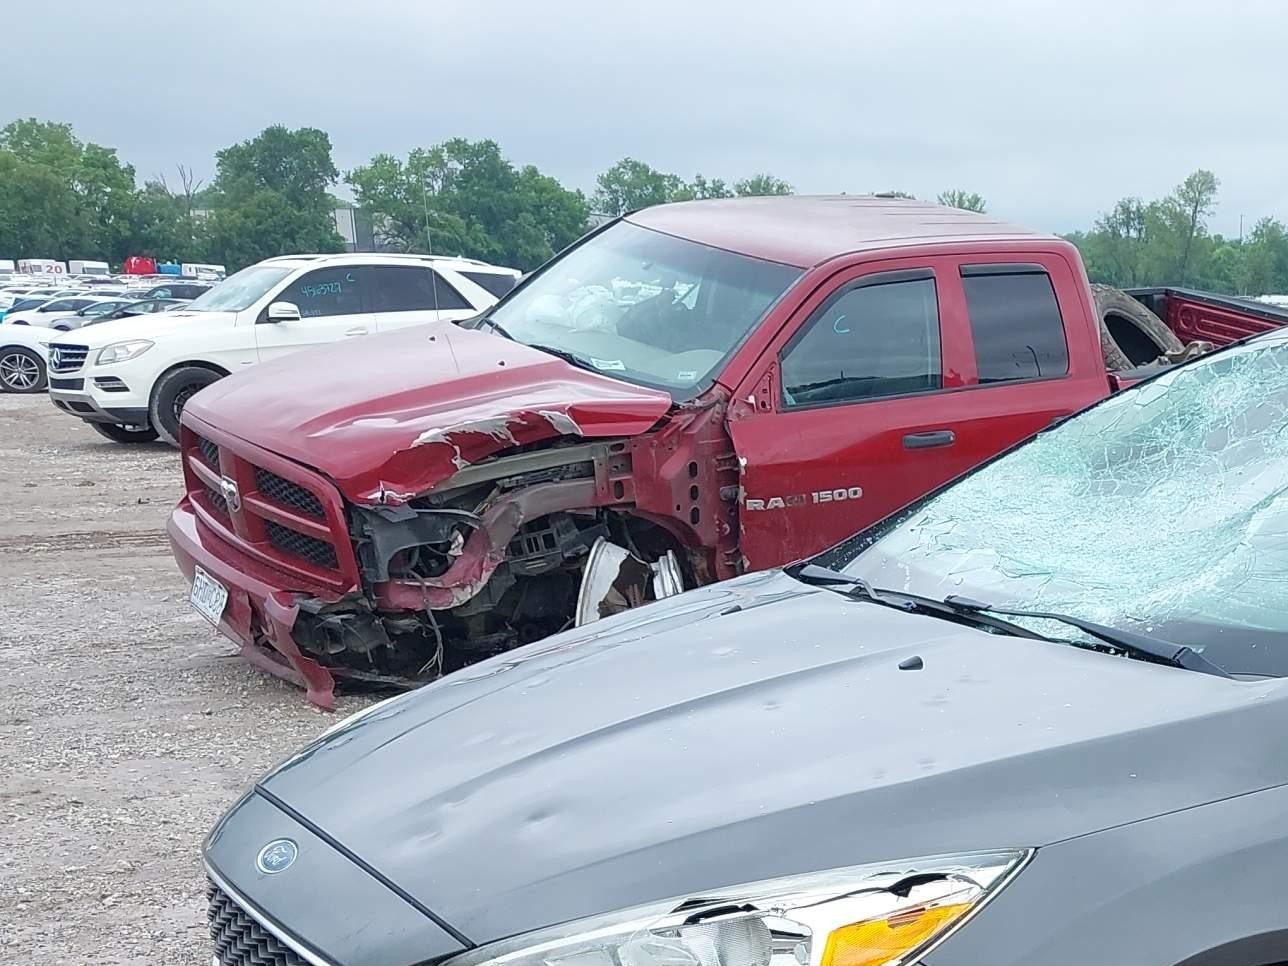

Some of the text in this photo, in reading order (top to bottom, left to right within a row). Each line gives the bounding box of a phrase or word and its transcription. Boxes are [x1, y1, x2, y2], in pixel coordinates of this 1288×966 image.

[46, 264, 62, 274] 20
[833, 314, 850, 333] C
[811, 487, 863, 504] 1500
